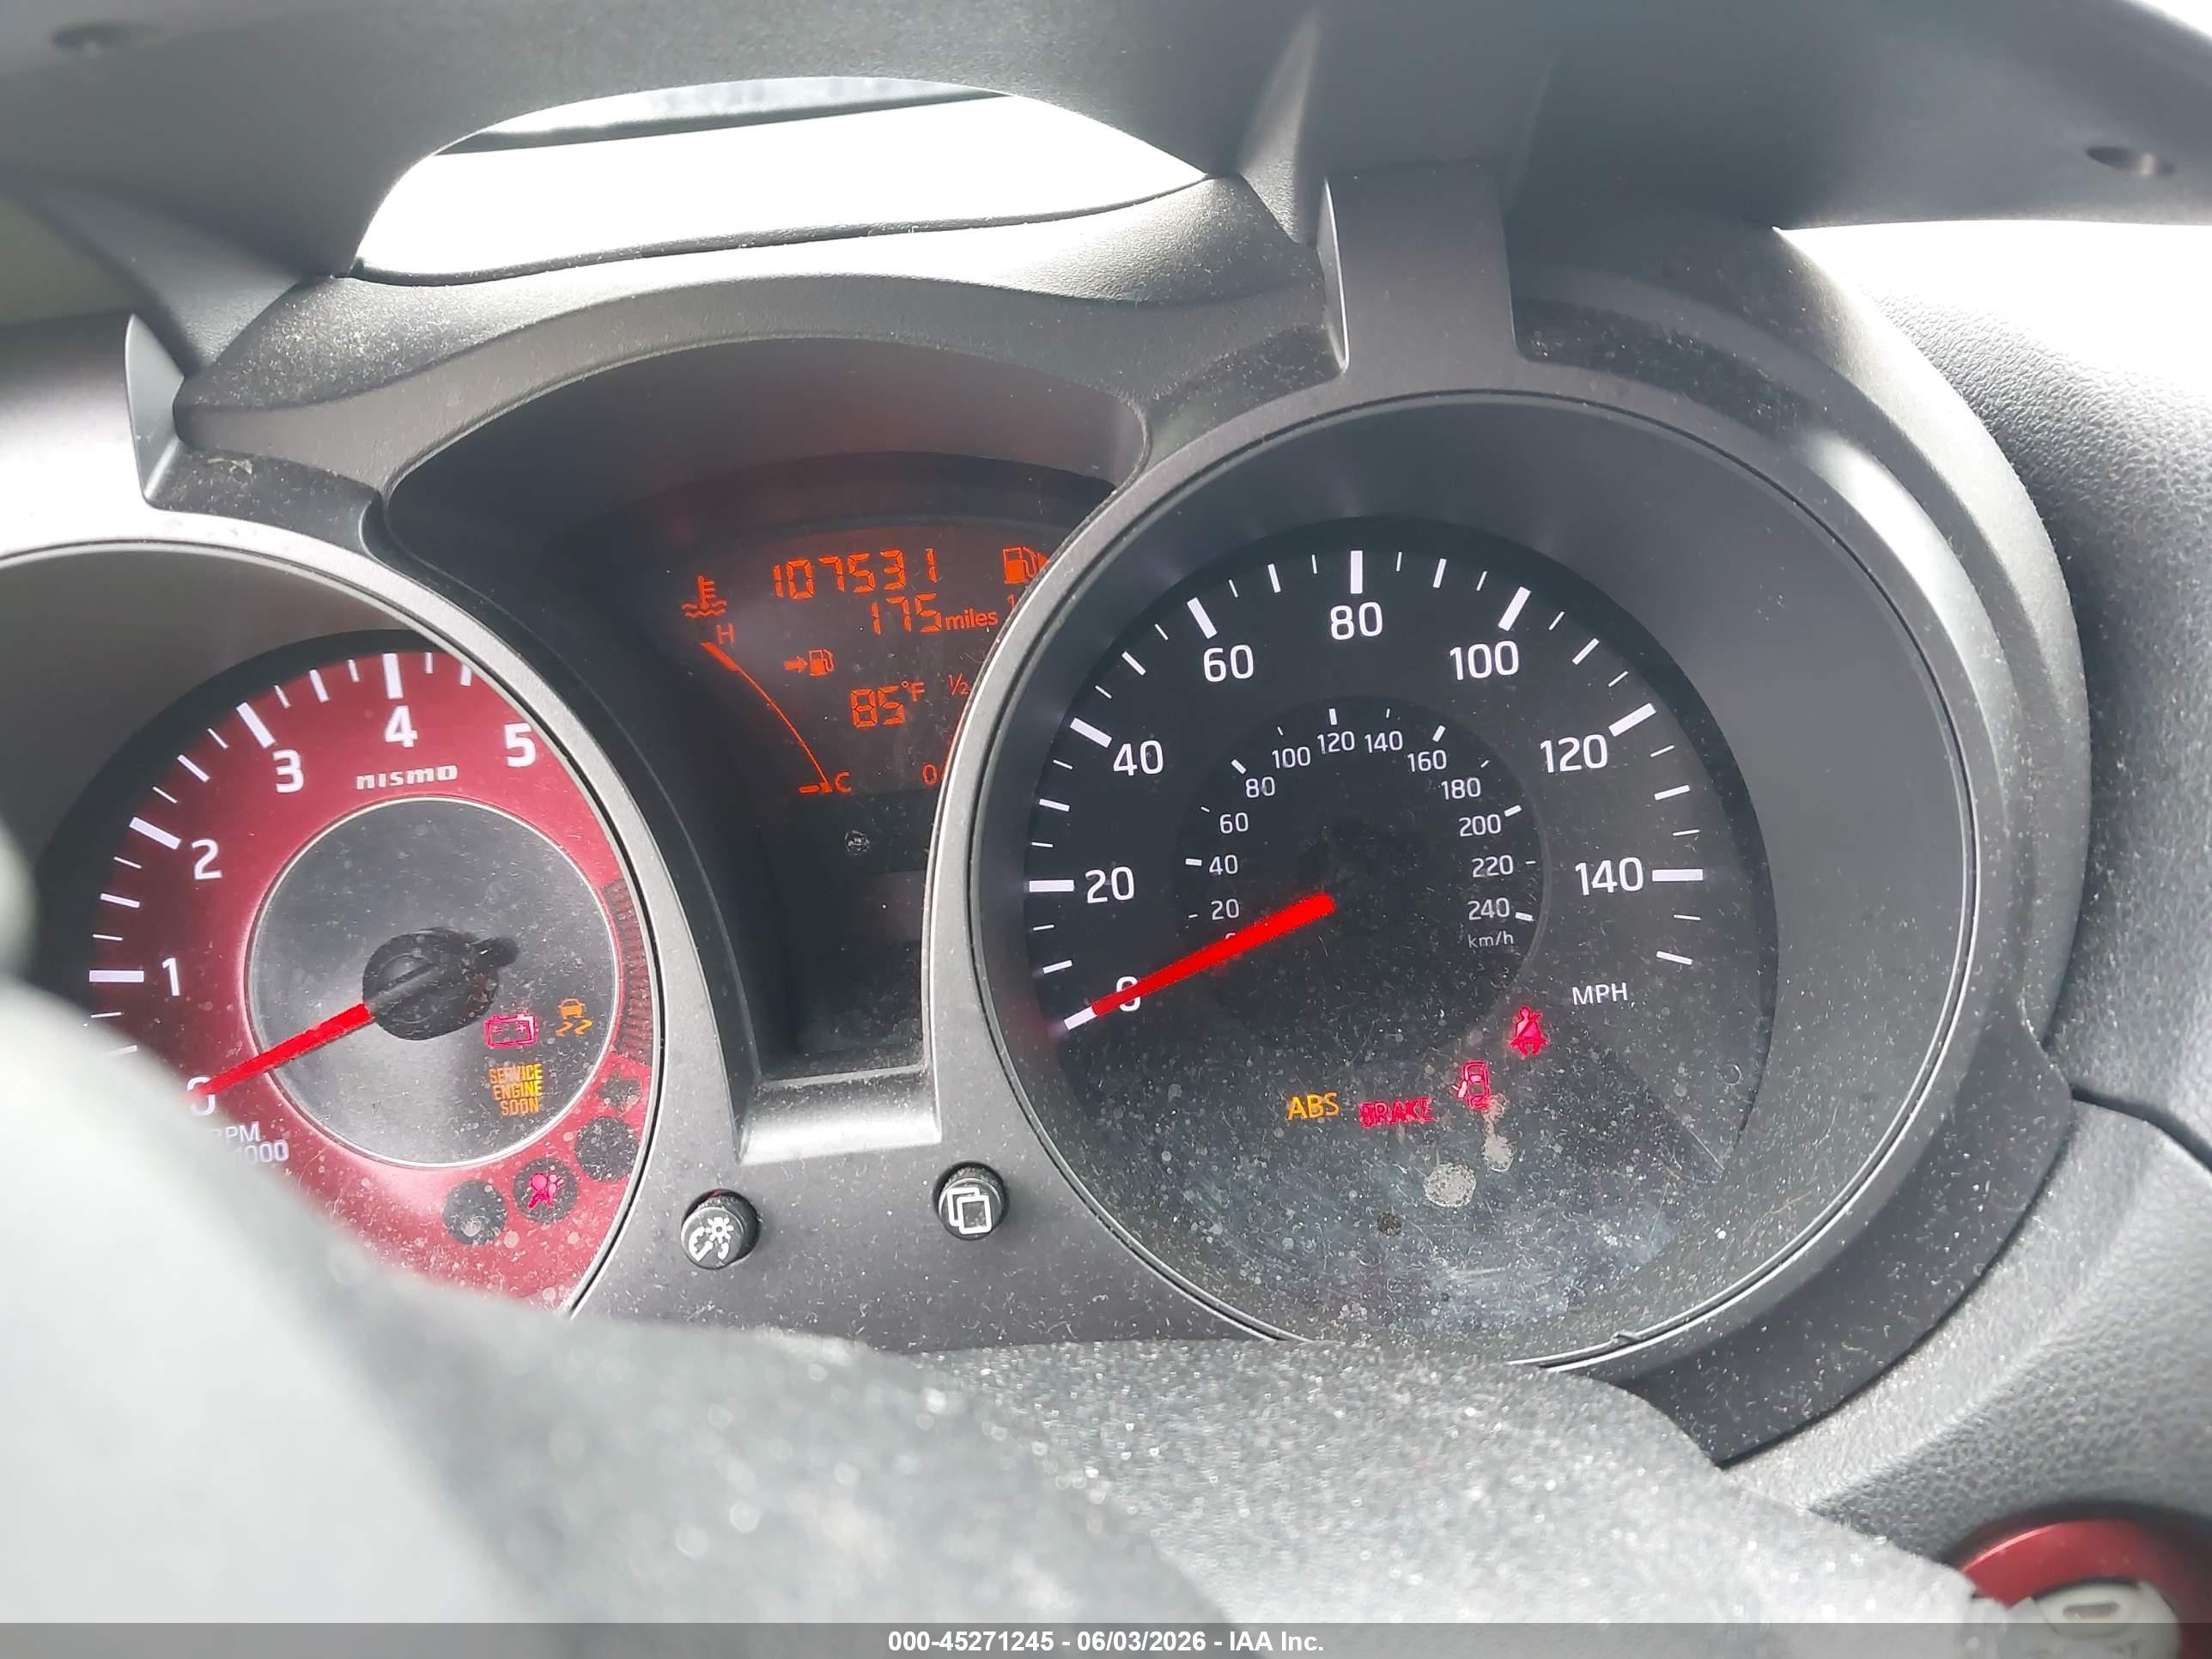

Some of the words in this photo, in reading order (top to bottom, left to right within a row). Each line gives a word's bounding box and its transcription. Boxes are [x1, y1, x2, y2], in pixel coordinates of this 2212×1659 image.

[774, 548, 939, 599] 107531
[871, 593, 942, 635] 175
[945, 608, 999, 631] miles
[1330, 601, 1382, 641] 80
[716, 623, 736, 645] H
[1203, 644, 1254, 683] 60
[1449, 641, 1519, 681] 100
[384, 705, 419, 749] 4
[504, 722, 537, 768] 5
[1317, 731, 1355, 755] 120
[1364, 731, 1403, 753] 140
[1540, 733, 1609, 774] 120
[1113, 740, 1164, 776] 40
[1272, 746, 1311, 769] 100
[1407, 750, 1447, 772] 160
[272, 749, 304, 793] 3
[834, 771, 852, 793] C
[1245, 776, 1275, 799] 80
[1441, 777, 1481, 800] 180
[1219, 811, 1249, 834] 60
[1458, 814, 1502, 837] 200
[191, 839, 222, 880] 2
[1209, 854, 1238, 875] 40
[1472, 854, 1514, 878] 220
[1085, 866, 1134, 904] 20
[1575, 857, 1644, 896] 140
[1211, 898, 1240, 921] 20
[1468, 897, 1510, 921] 240
[1468, 930, 1514, 949] km/h
[161, 957, 180, 996] 1
[1571, 981, 1628, 1006] MPH
[489, 1064, 543, 1085] SERVICE
[493, 1080, 543, 1101] ENGINE
[501, 1097, 539, 1116] SOON
[1287, 1091, 1340, 1120] ABS
[1359, 1097, 1434, 1128] BRAKE
